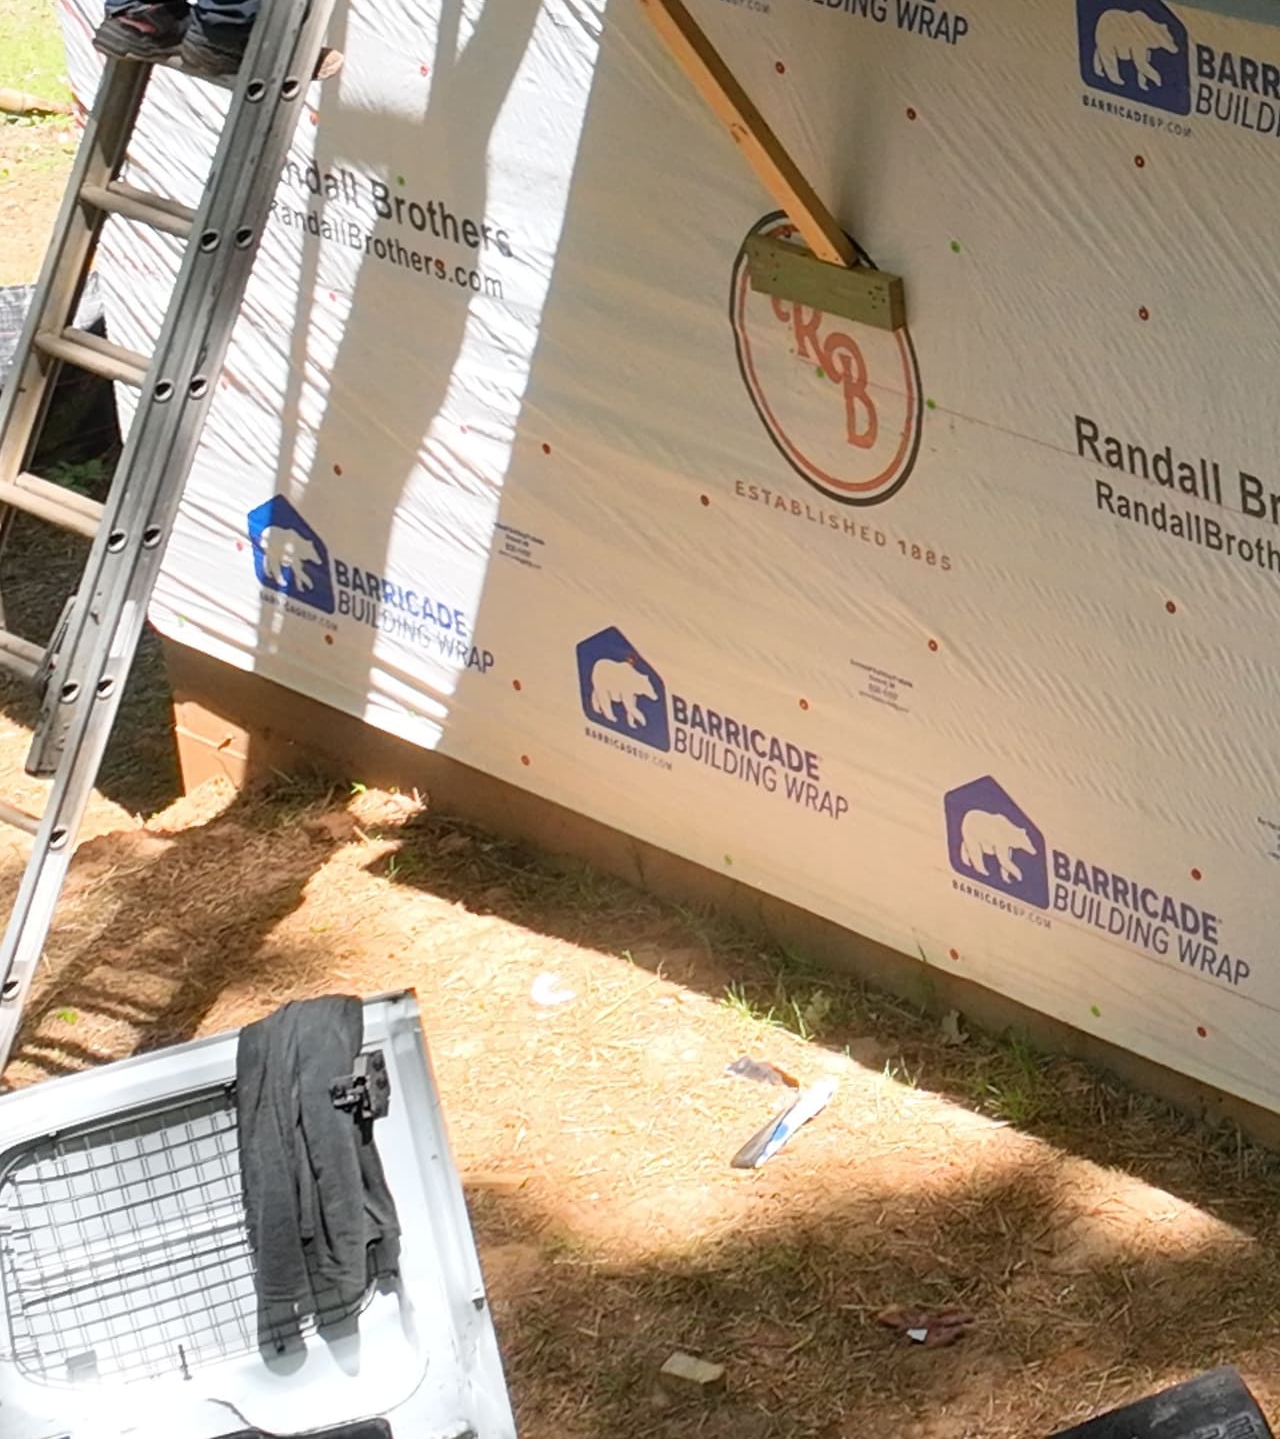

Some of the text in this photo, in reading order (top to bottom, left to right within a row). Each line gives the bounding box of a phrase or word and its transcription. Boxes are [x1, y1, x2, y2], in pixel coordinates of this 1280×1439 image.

[369, 177, 513, 258] Brothers
[1074, 414, 1223, 506] Randall
[735, 480, 953, 572] ESTABLISHED 1885
[334, 558, 468, 637] BARRICADE
[337, 589, 495, 674] BUILDING WRAP
[671, 694, 821, 782] BARRICADE
[672, 726, 850, 821] BUILDING WRAP
[1052, 849, 1219, 946] BARRICADE
[1052, 882, 1250, 986] BUILDING WRAP
